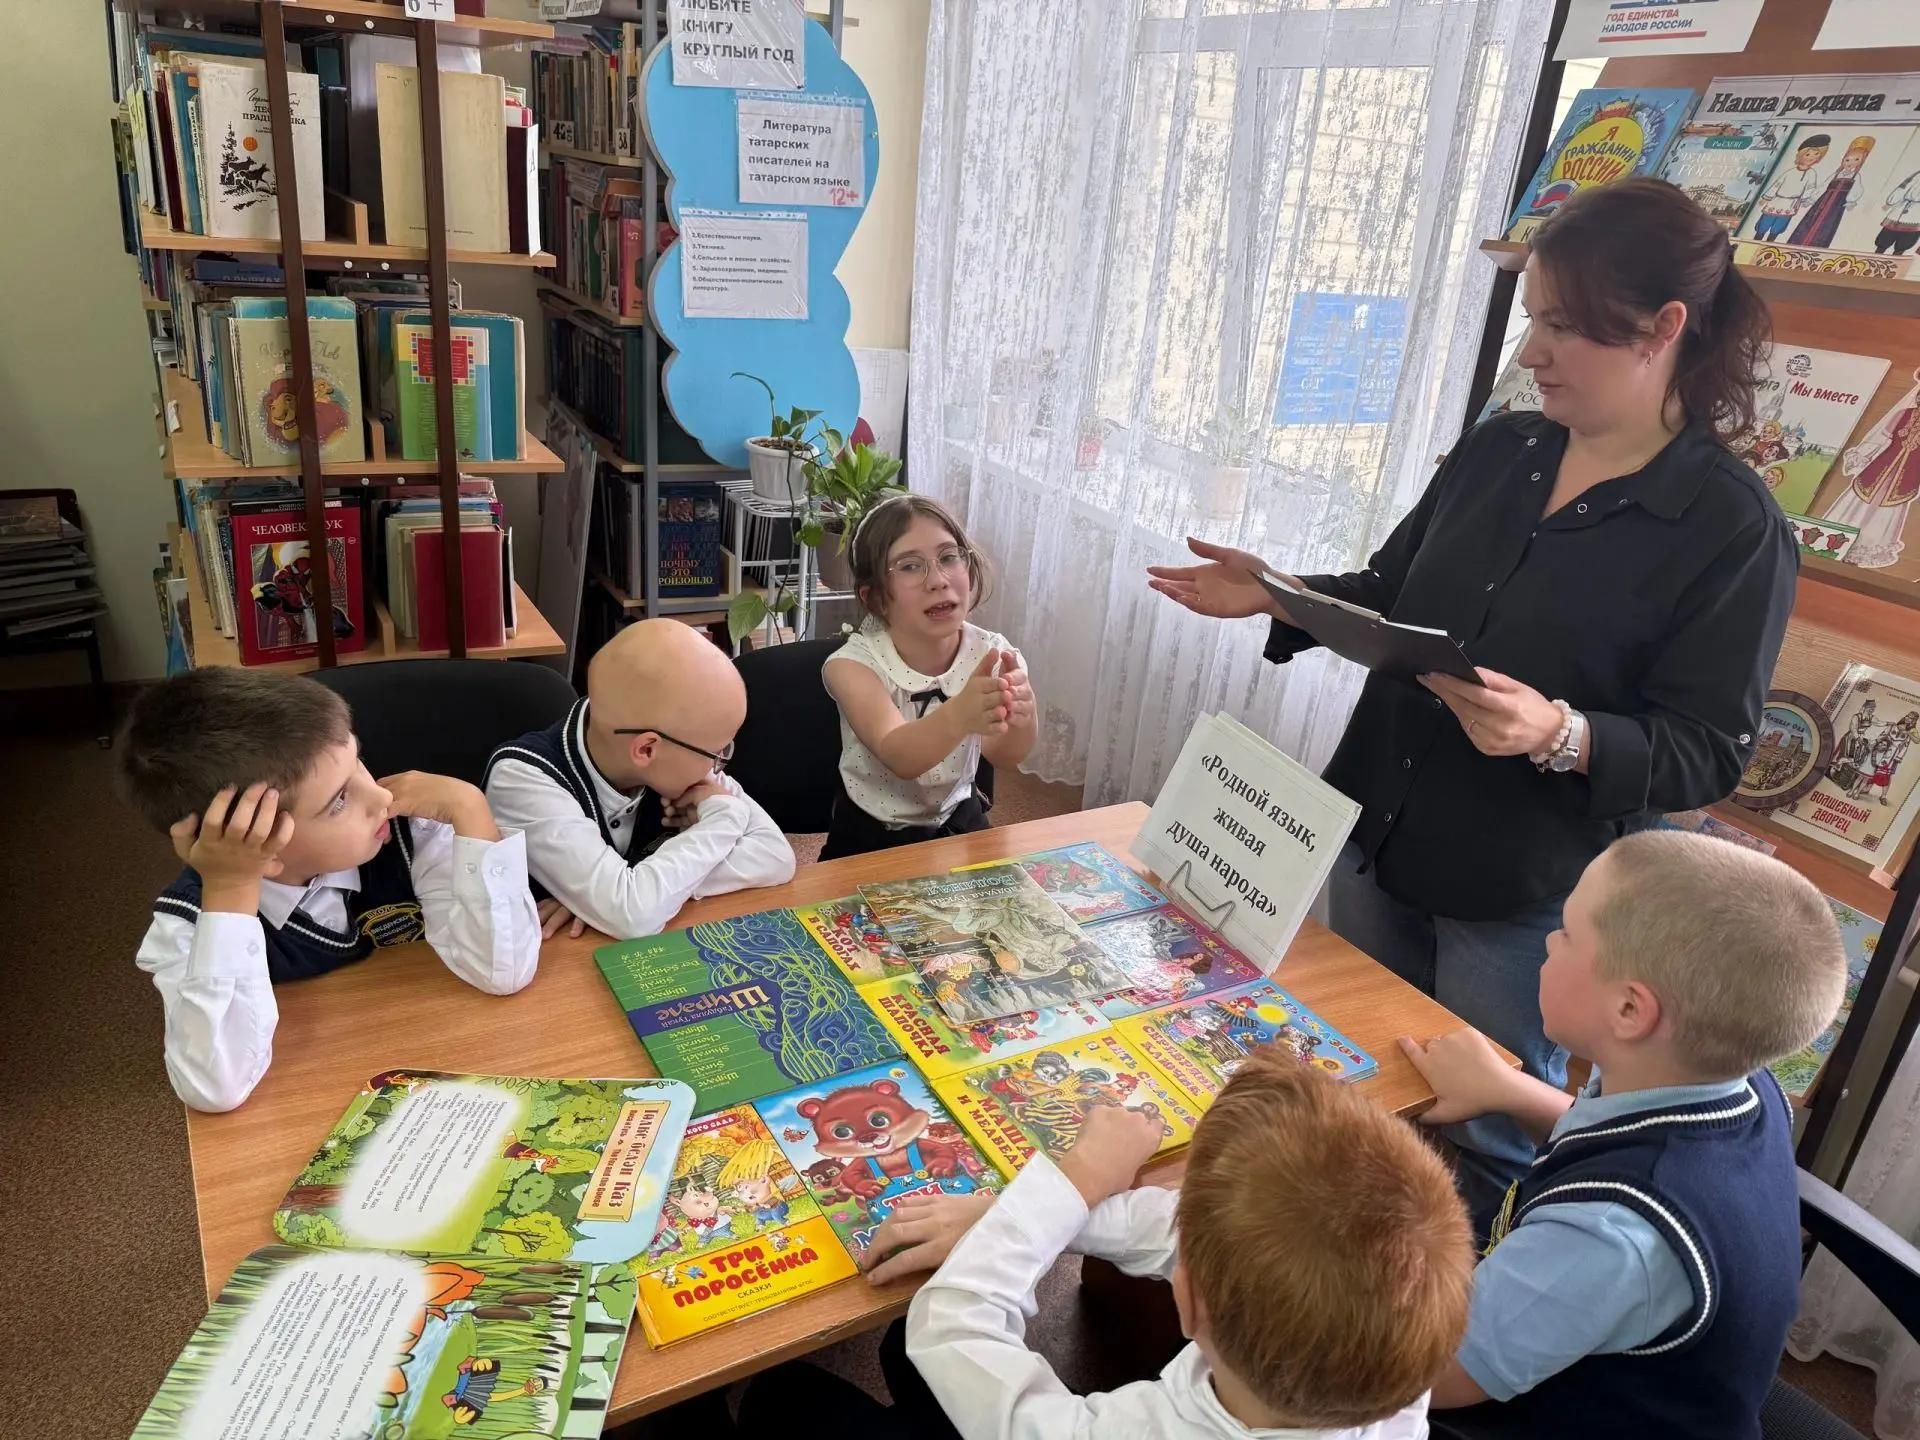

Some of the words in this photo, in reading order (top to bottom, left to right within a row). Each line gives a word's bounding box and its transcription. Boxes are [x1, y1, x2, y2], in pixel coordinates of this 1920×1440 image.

[1606, 10, 1625, 22] ГОД
[1627, 9, 1680, 20] ЕДИНСТВА
[682, 19, 733, 34] КНИГУ
[1602, 21, 1648, 33] НАРОДОВ
[1650, 19, 1692, 30] РОССИИ
[684, 42, 758, 60] КРУГЛЫЙ
[764, 48, 794, 63] ГОД
[1707, 92, 1779, 113] Наша
[1777, 93, 1886, 116] родина
[763, 119, 832, 134] Литература
[1601, 126, 1619, 142] Я
[749, 138, 809, 151] татарских
[1564, 140, 1637, 163] ГРАЖДАНИН
[748, 155, 812, 168] писателей
[815, 160, 829, 169] на
[1562, 155, 1626, 184] РОССИИ
[749, 173, 810, 186] татарском
[813, 177, 850, 187] языке
[830, 187, 859, 205] 12+
[1790, 381, 1812, 397] Мы
[1814, 388, 1859, 405] вместе
[660, 560, 701, 568] ПОЧЕМУ
[672, 568, 690, 576] ЭТО
[658, 577, 713, 585] РОИЗОШЛО
[1201, 753, 1271, 813] «Родной
[1267, 806, 1316, 853] язык,
[1810, 790, 1872, 823] ВОЛШЕБНЫЙ
[1811, 808, 1852, 833] ДВОРЕЦ
[1213, 807, 1267, 858] живая
[1166, 820, 1211, 861] душа
[1211, 853, 1278, 917] народа»
[808, 916, 818, 925] В
[816, 925, 861, 971] САПОГАХ
[831, 928, 861, 953] КОТ
[659, 1014, 690, 1028] Тукай
[689, 1003, 733, 1020] Габдулла
[877, 996, 934, 1058] ШАПОЧКА
[890, 993, 952, 1055] КРАСНАЯ
[1301, 1016, 1366, 1064] СКАЗОК
[1101, 1036, 1138, 1069] ПЯТЬ
[1136, 1072, 1197, 1130] СКАЗОК
[957, 1094, 972, 1105] И
[709, 1116, 735, 1130] САДА
[977, 1096, 1037, 1160] МАША
[602, 1166, 613, 1176] and
[606, 1157, 617, 1165] Fox
[598, 1177, 609, 1186] the
[590, 1187, 606, 1207] Goose
[607, 1181, 631, 1207] Каз
[709, 1245, 765, 1273] ТРИ
[673, 1247, 819, 1308] ПОРОСЁНКА
[737, 1282, 772, 1299] СКАЗКИ
